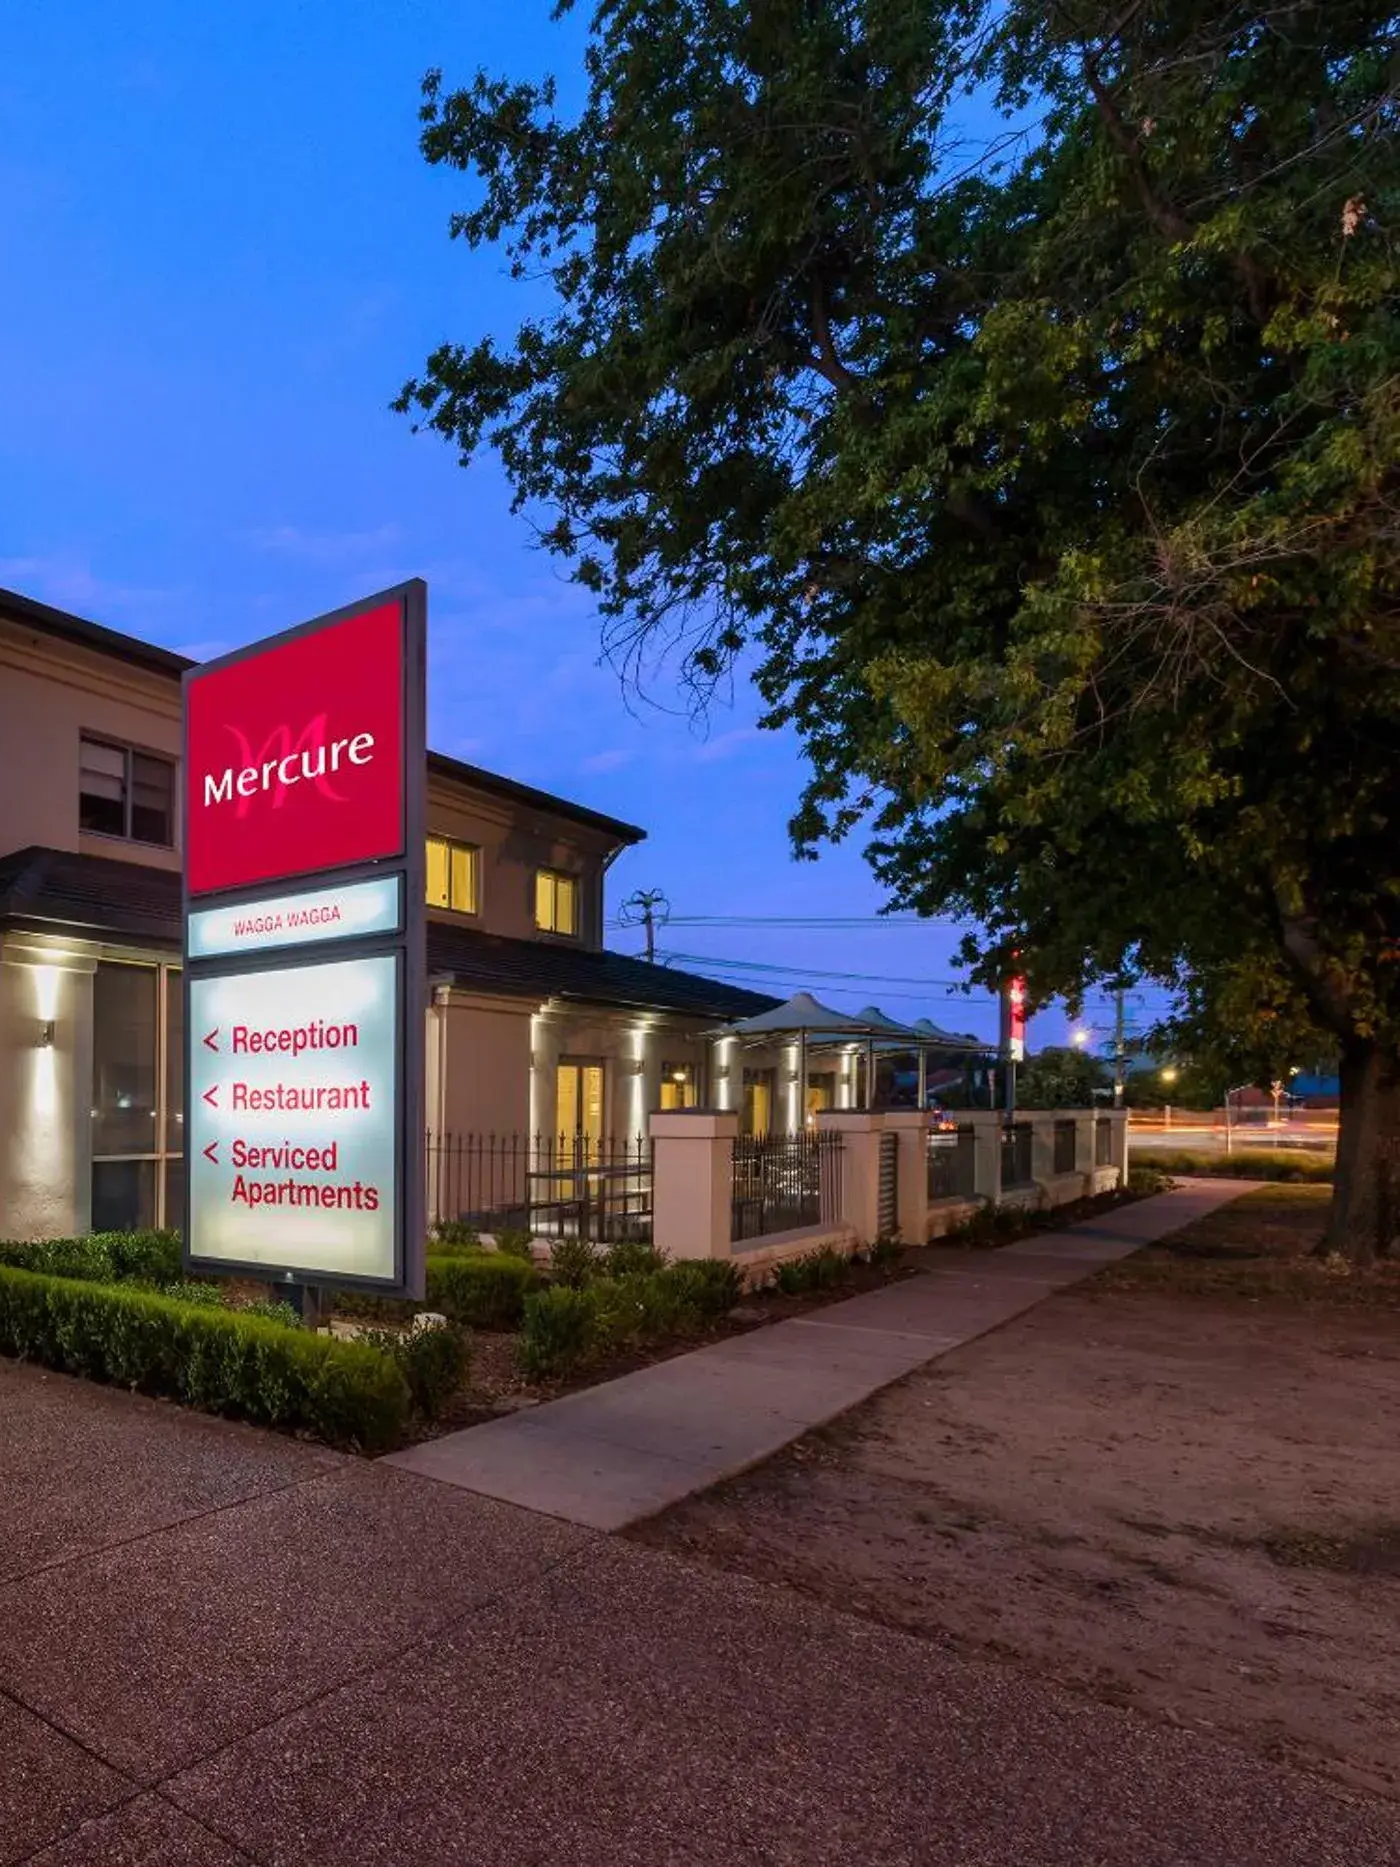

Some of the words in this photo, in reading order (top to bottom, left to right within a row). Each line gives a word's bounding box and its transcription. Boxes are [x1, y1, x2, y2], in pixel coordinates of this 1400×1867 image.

[204, 732, 375, 807] Mercure
[234, 917, 282, 936] WAGGA
[287, 905, 341, 928] WAGGA
[232, 1020, 358, 1057] Reception
[232, 1080, 370, 1111] Restaurant
[232, 1139, 338, 1172] Serviced
[231, 1174, 380, 1211] Apartments
